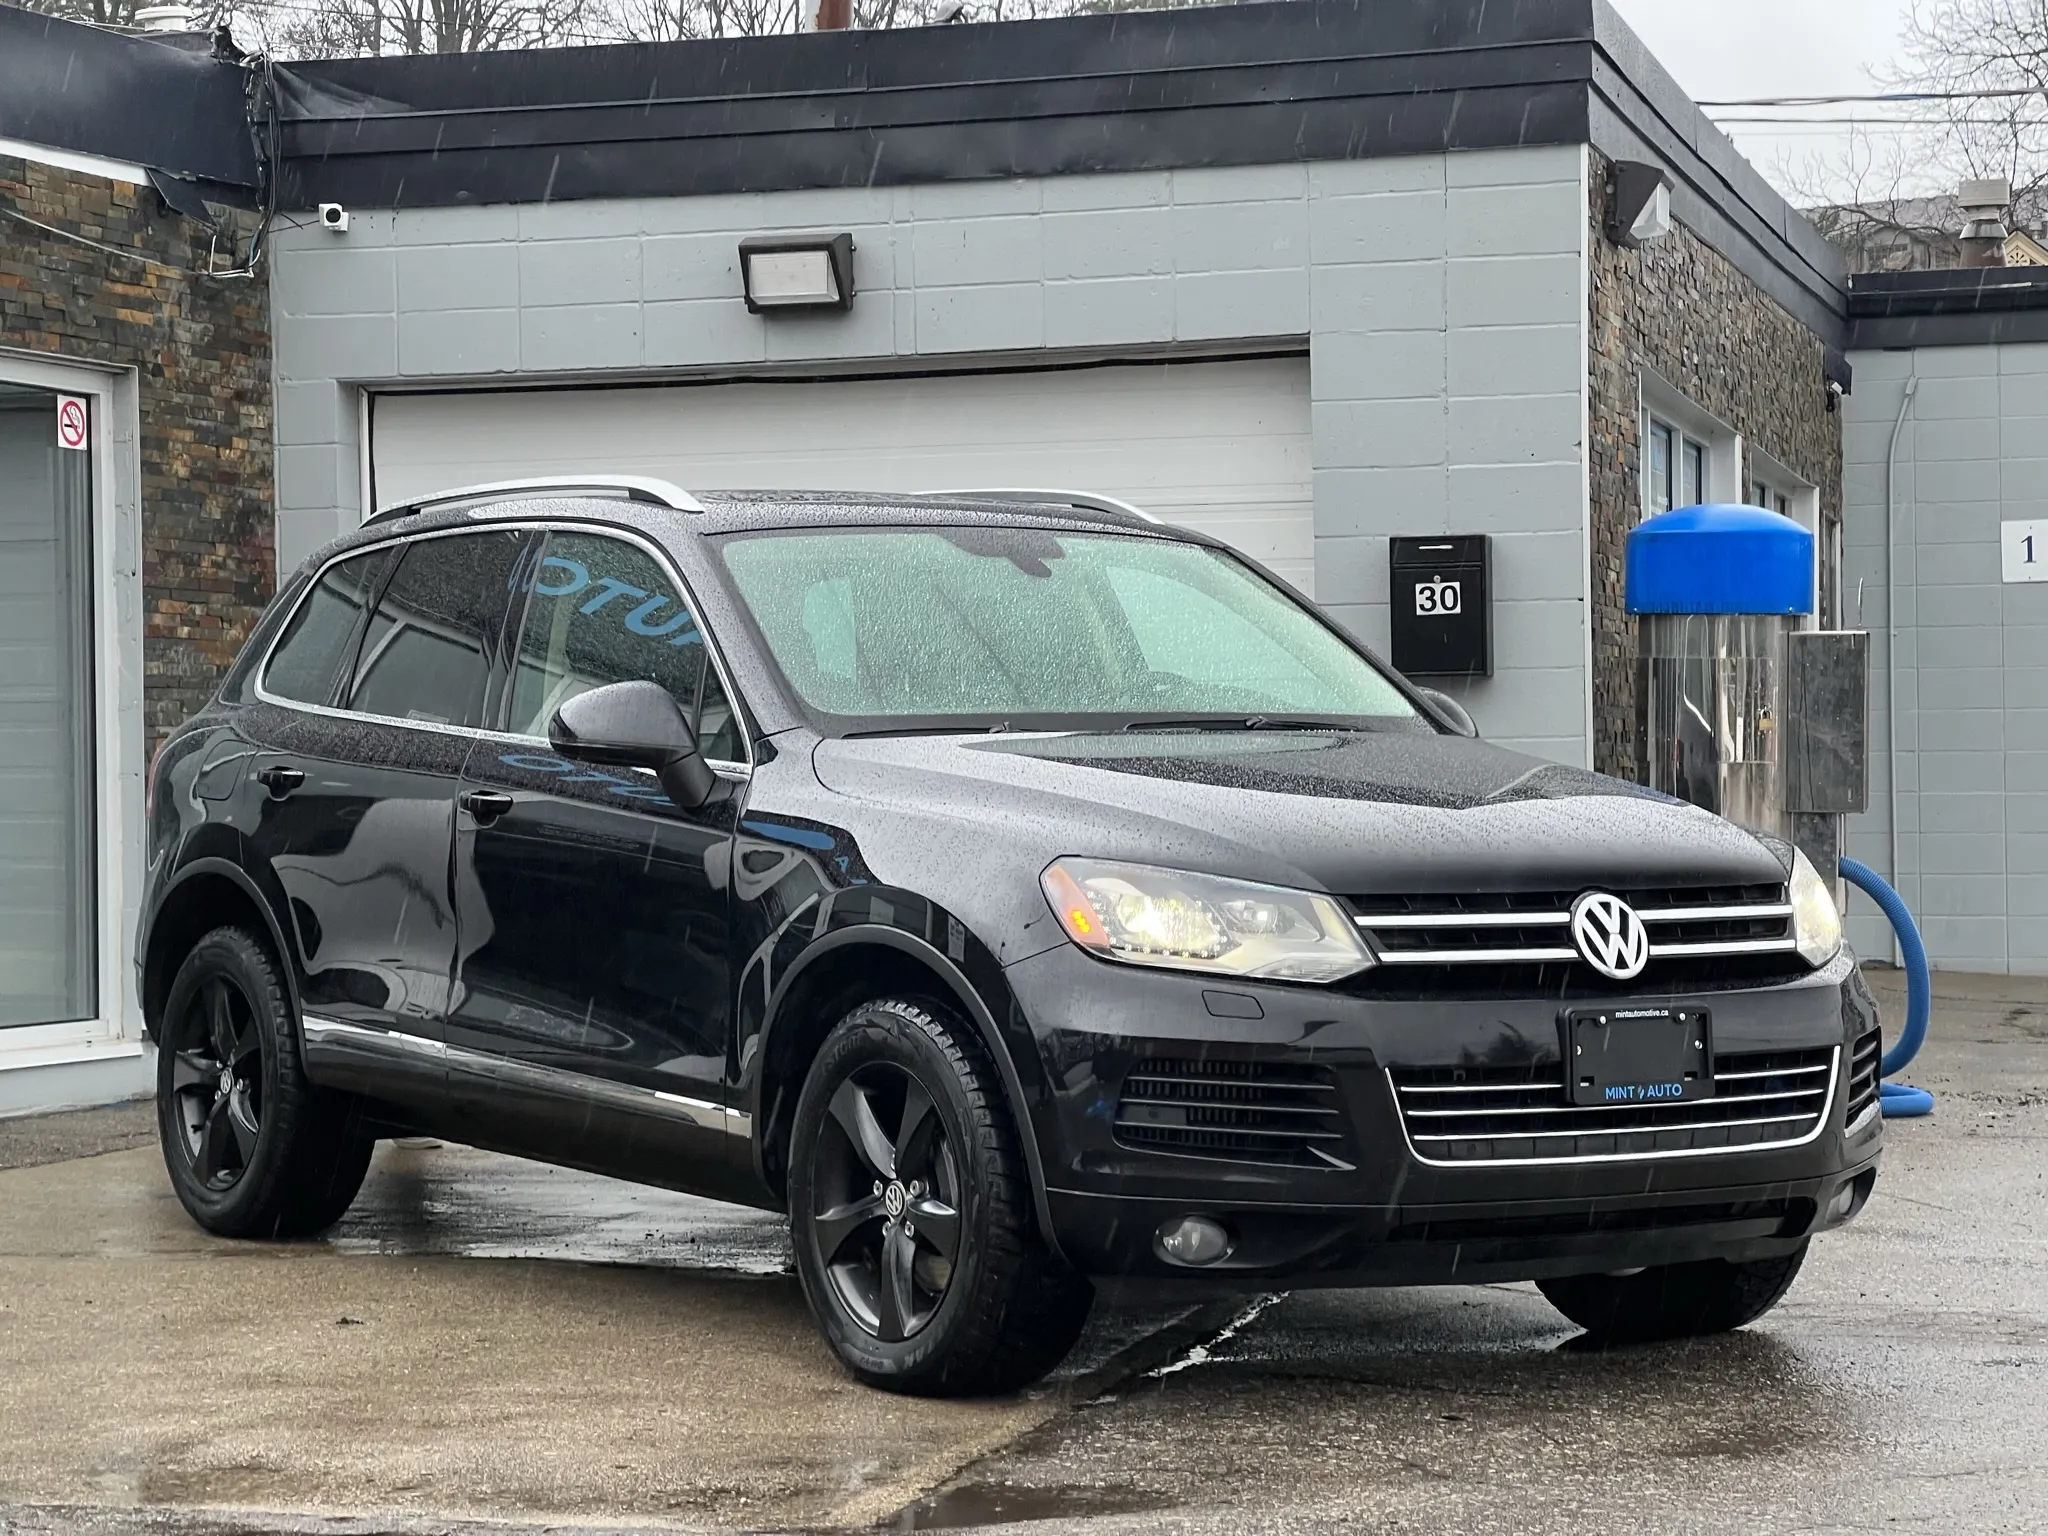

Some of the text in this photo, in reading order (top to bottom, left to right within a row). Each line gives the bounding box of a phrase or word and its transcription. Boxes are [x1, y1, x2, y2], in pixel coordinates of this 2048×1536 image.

[2021, 535, 2037, 564] 1
[1418, 585, 1459, 612] 30
[1576, 894, 1646, 977] VW
[1615, 1008, 1669, 1018] mintautomotive.ca
[1605, 1083, 1683, 1100] MINT AUTO
